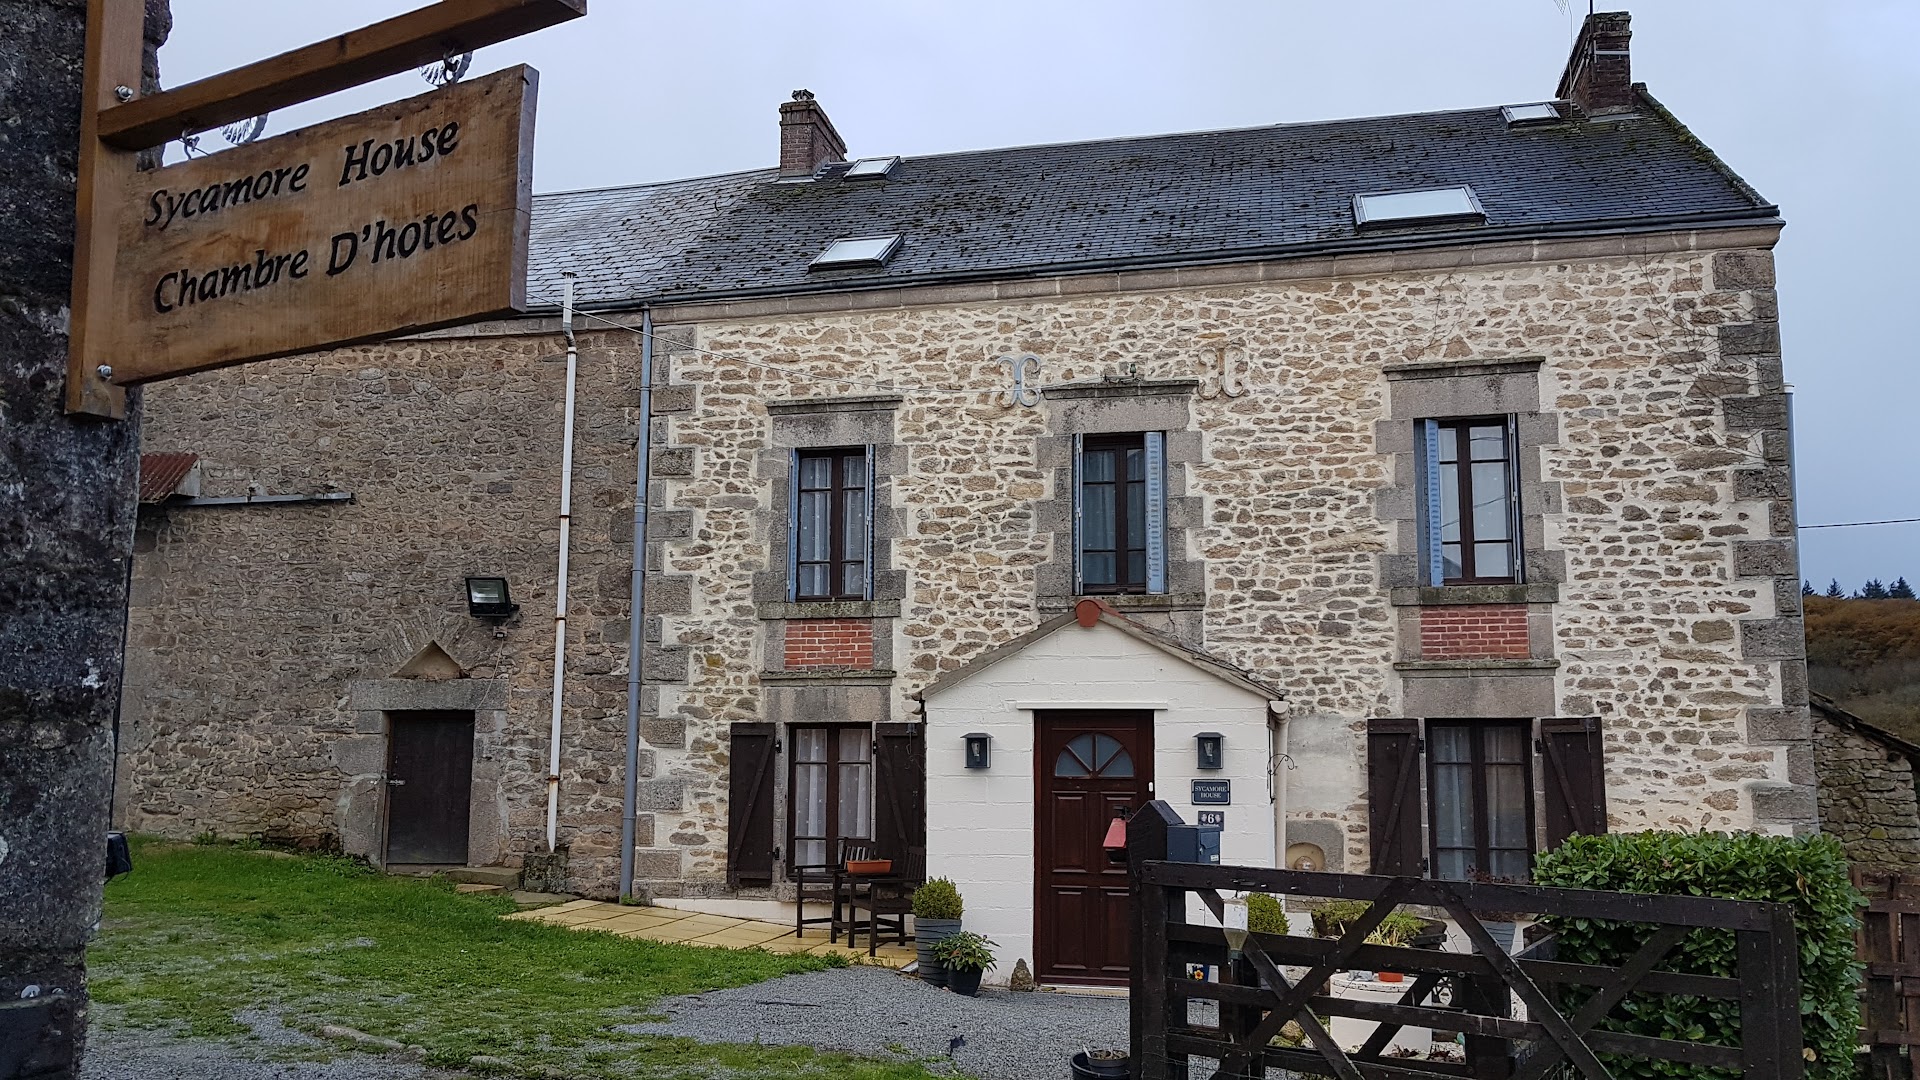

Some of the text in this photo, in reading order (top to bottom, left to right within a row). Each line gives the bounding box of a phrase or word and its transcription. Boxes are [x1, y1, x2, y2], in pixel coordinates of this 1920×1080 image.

[144, 121, 460, 231] Sycamore House
[154, 203, 479, 313] Chambre D'hotes
[1207, 813, 1215, 824] 6
